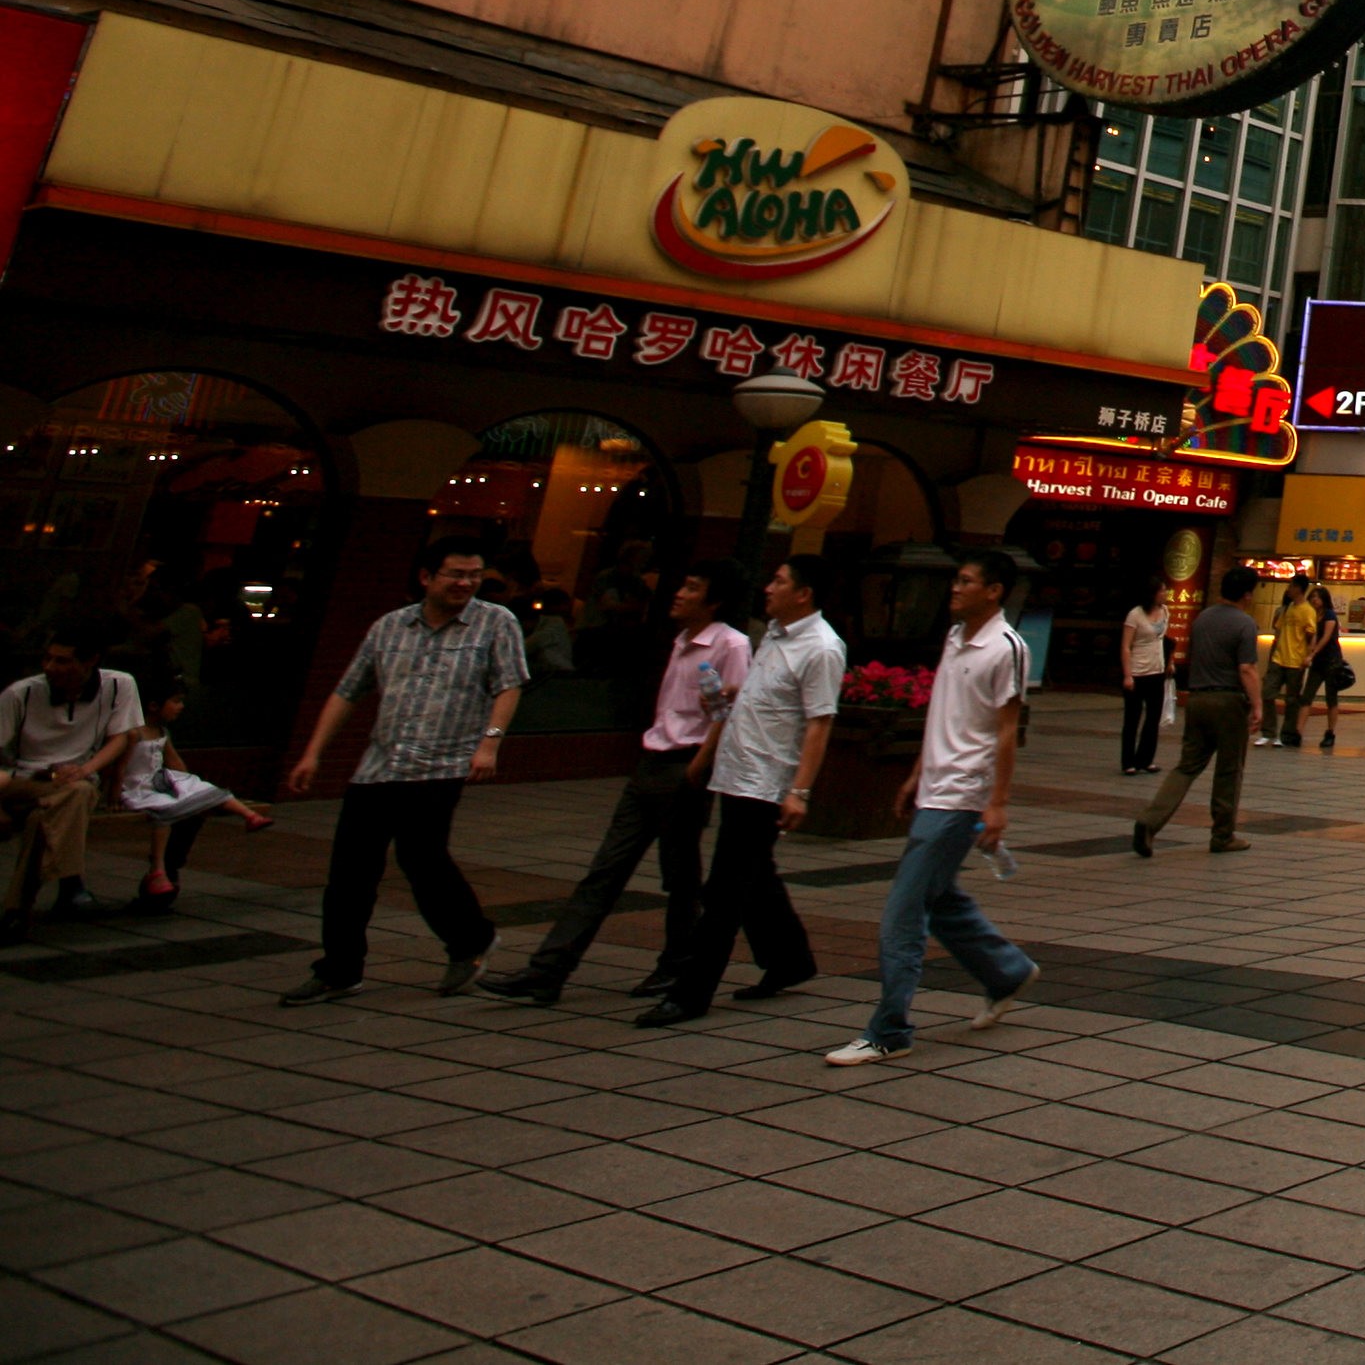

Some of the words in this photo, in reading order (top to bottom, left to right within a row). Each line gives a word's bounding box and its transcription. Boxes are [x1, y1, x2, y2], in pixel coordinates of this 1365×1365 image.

[1067, 56, 1159, 96] HARVEST
[1165, 70, 1214, 94] THAI
[1221, 18, 1301, 77] OPERA
[697, 188, 861, 242] ALOHA
[381, 273, 996, 405] 热风哈罗哈休闲餐厅
[1097, 406, 1168, 435] 狮子桥店
[1027, 479, 1092, 498] Harvest
[1102, 485, 1136, 501] Thai
[1143, 490, 1189, 506] Opera
[1195, 494, 1228, 510] Cafe
